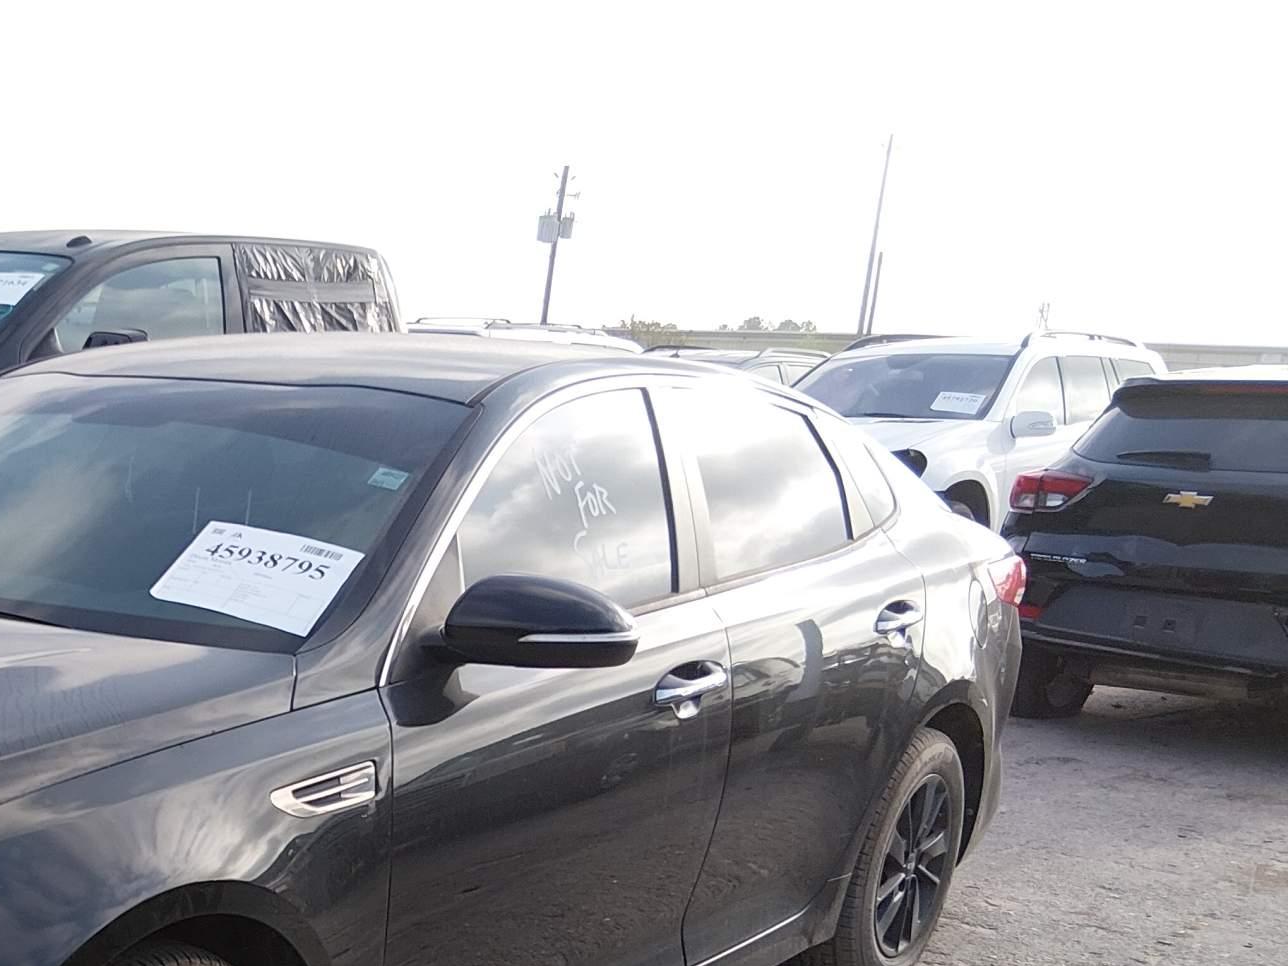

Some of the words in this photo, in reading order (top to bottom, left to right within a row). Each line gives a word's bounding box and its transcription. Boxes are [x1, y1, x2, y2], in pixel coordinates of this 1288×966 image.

[535, 444, 582, 500] NOT
[574, 481, 617, 529] FOR
[205, 543, 331, 580] 45938795
